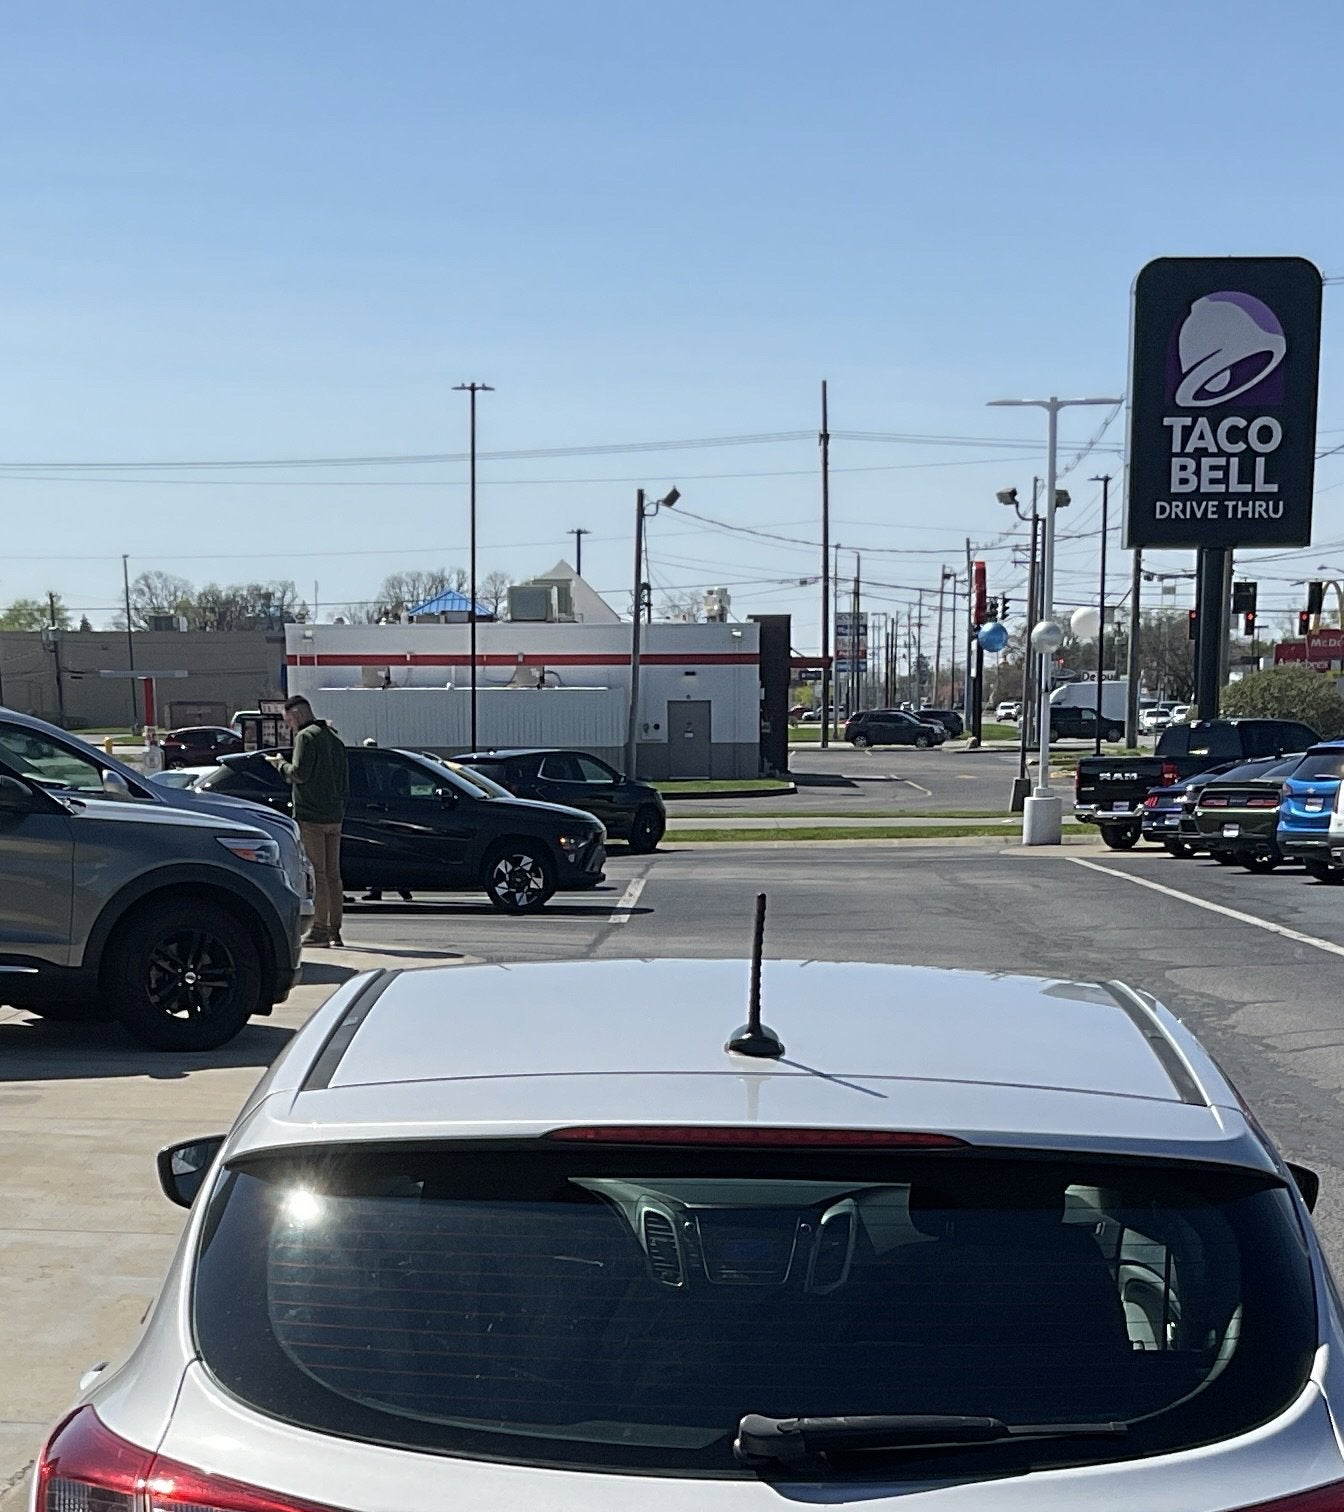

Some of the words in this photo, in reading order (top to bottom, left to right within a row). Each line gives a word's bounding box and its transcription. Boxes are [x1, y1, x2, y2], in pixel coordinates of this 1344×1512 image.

[1163, 416, 1283, 453] TACO
[1170, 457, 1279, 493] BELL
[1156, 501, 1219, 519] DRIVE
[1224, 501, 1284, 518] THRU
[1082, 672, 1118, 681] Deou
[1099, 773, 1138, 781] RAM
